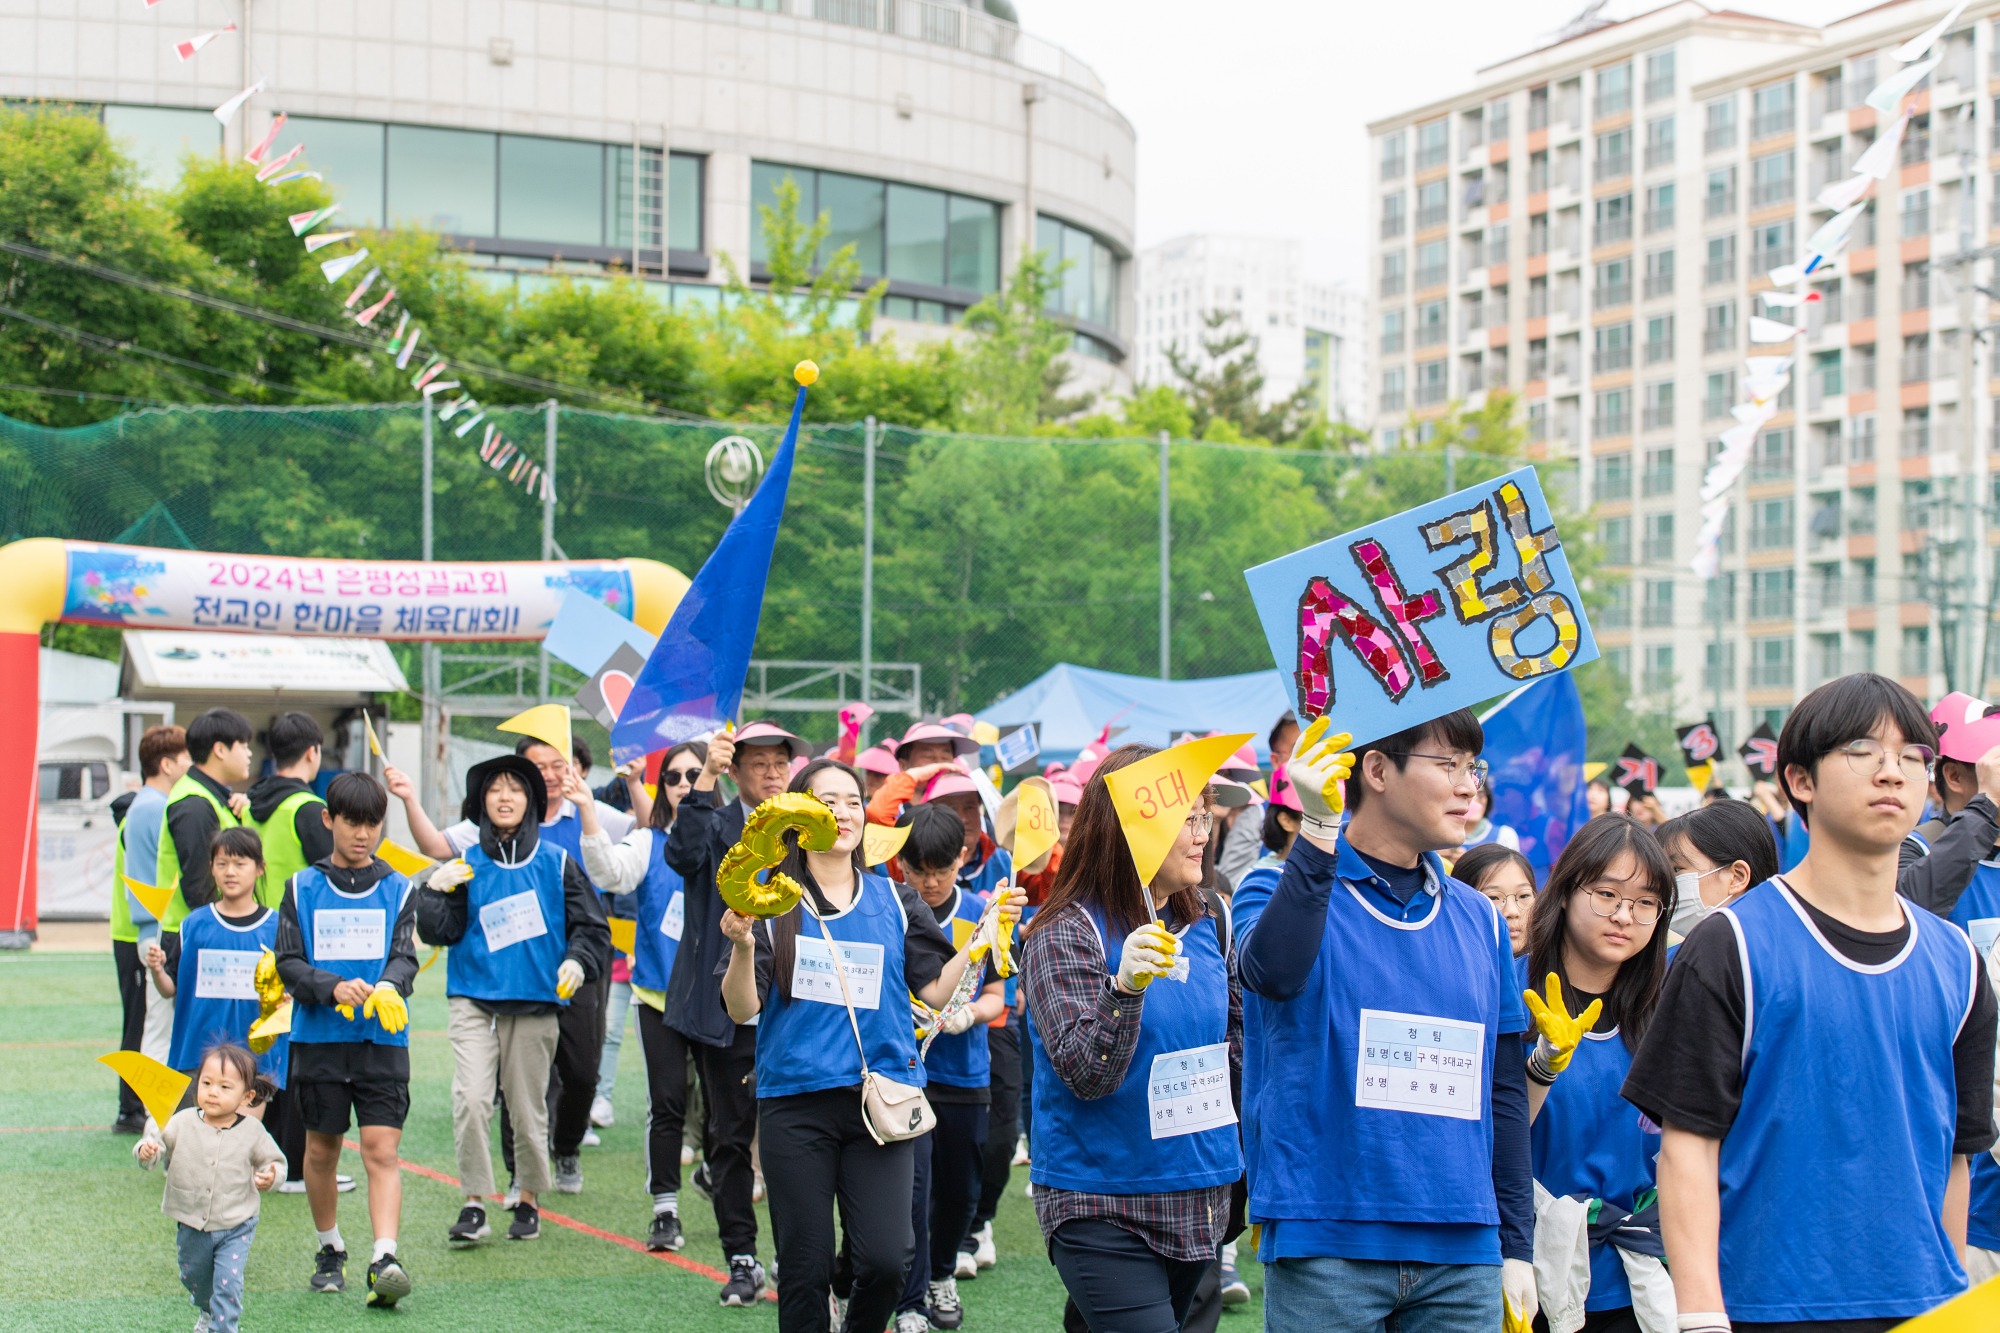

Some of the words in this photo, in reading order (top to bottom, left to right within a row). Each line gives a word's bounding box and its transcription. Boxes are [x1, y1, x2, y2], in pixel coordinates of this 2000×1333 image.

[208, 561, 325, 594] 2024년
[337, 566, 508, 598] 은평성길교회
[193, 595, 282, 631] 전교인
[293, 601, 383, 635] 한마음
[392, 604, 520, 636] 체육대회!
[1293, 479, 1582, 723] 사랑
[1134, 768, 1191, 820] 3대
[1442, 1056, 1473, 1070] 3대교구
